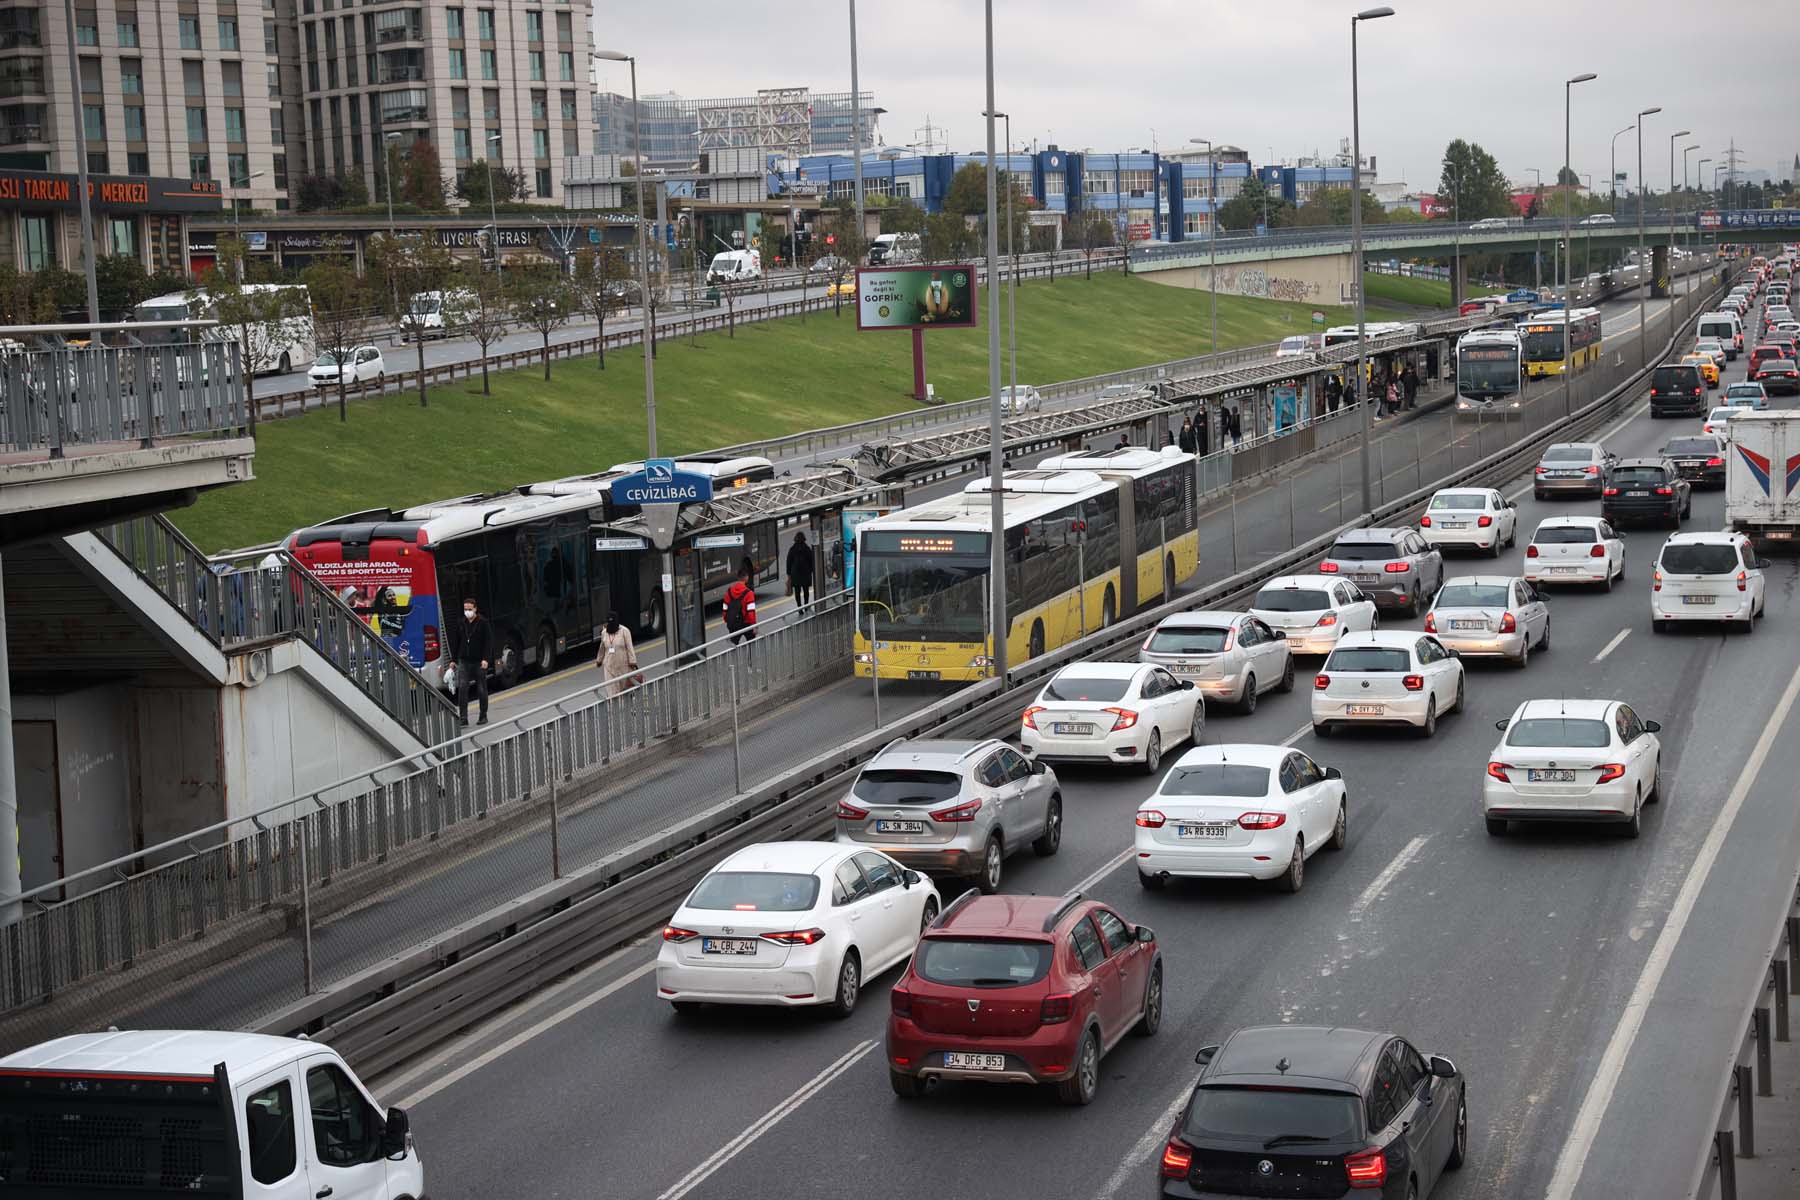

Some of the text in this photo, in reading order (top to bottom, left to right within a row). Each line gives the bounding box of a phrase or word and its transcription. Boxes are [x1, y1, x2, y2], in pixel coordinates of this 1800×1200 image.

[24, 179, 69, 200] TARCAN
[101, 181, 149, 204] MERKEZİ
[865, 294, 903, 303] GOFRİK!
[626, 485, 697, 500] CEVİZLİBAĞ
[354, 560, 369, 568] BİR
[369, 561, 400, 569] ARADA,
[1561, 771, 1573, 779] 304
[881, 822, 921, 830] 34 SN 3844
[1183, 827, 1224, 836] 34 RG 9339
[707, 940, 754, 951] 34 CBL 244
[949, 1053, 960, 1065] 34
[985, 1055, 1003, 1067] 853
